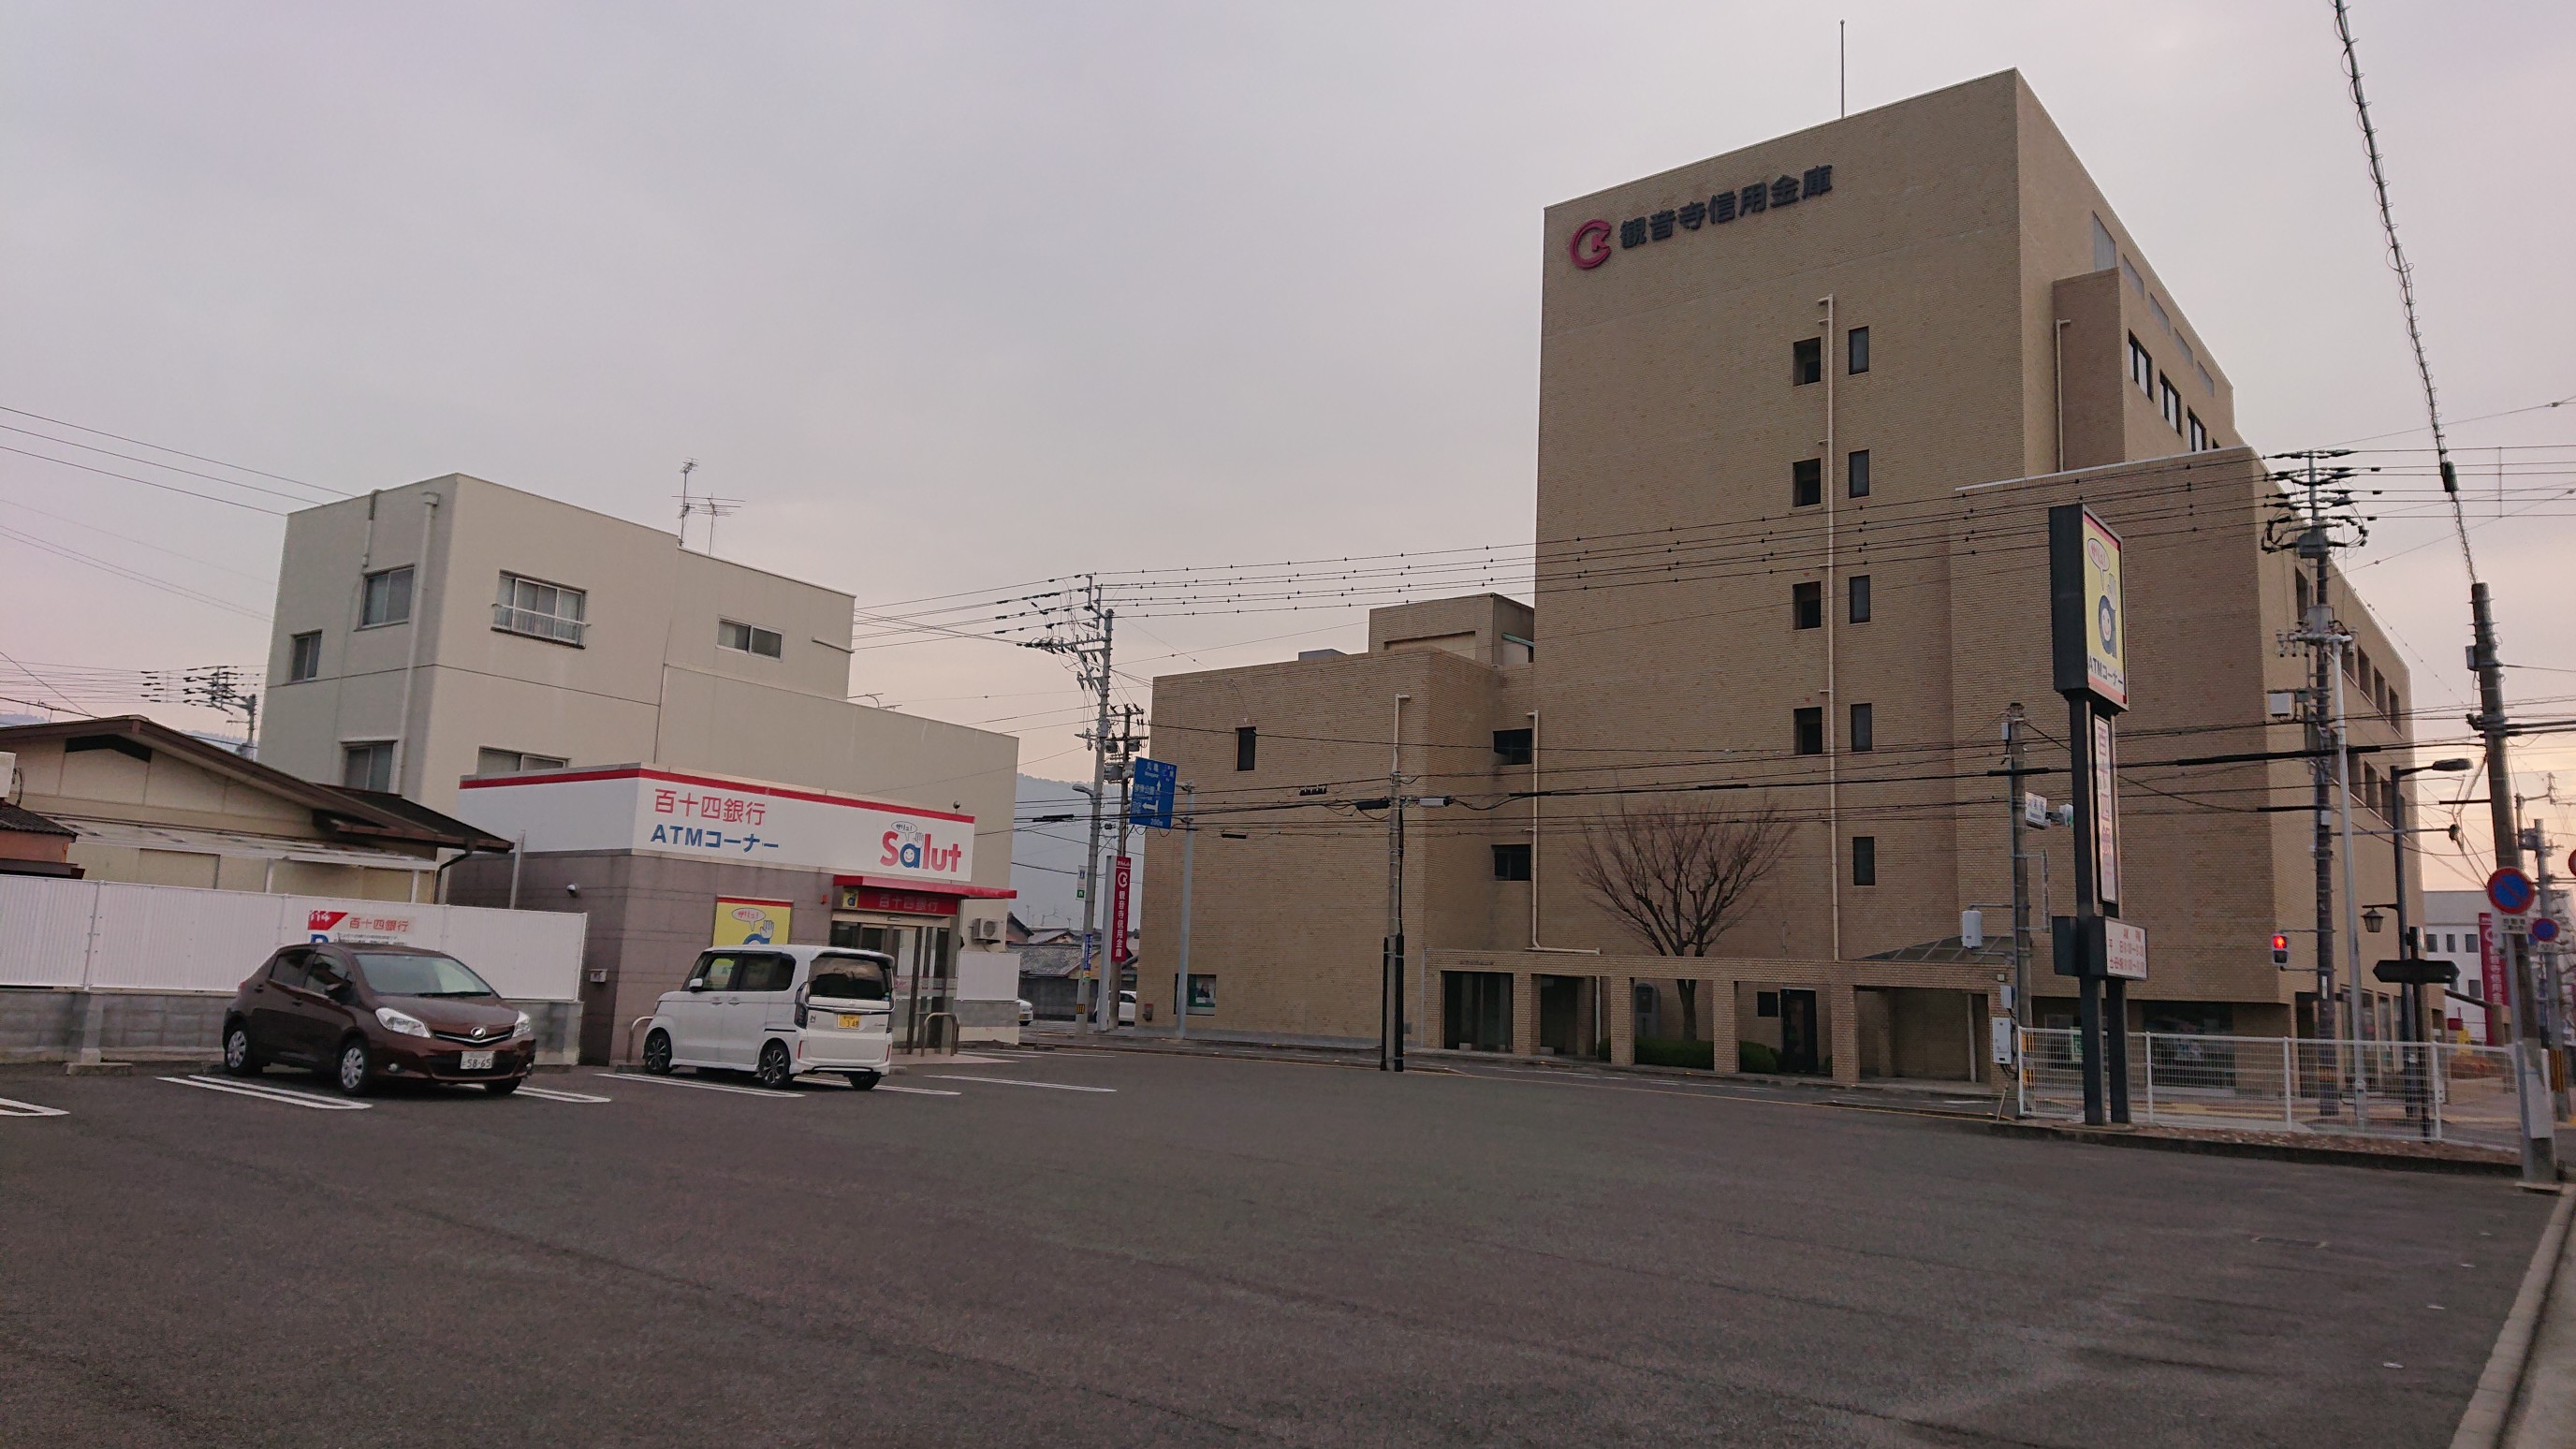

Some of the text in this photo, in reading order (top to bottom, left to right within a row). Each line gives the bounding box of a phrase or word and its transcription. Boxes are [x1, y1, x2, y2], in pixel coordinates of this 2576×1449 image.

[1619, 164, 1834, 249] 観音寺信用金庫
[2088, 655, 2124, 686] ATMコーナー
[654, 788, 766, 826] 百十四銀行
[650, 824, 780, 853] ATMコーナー
[880, 830, 961, 872] Salut
[879, 893, 939, 913] 百十四銀行
[349, 916, 408, 932] 百十四銀行
